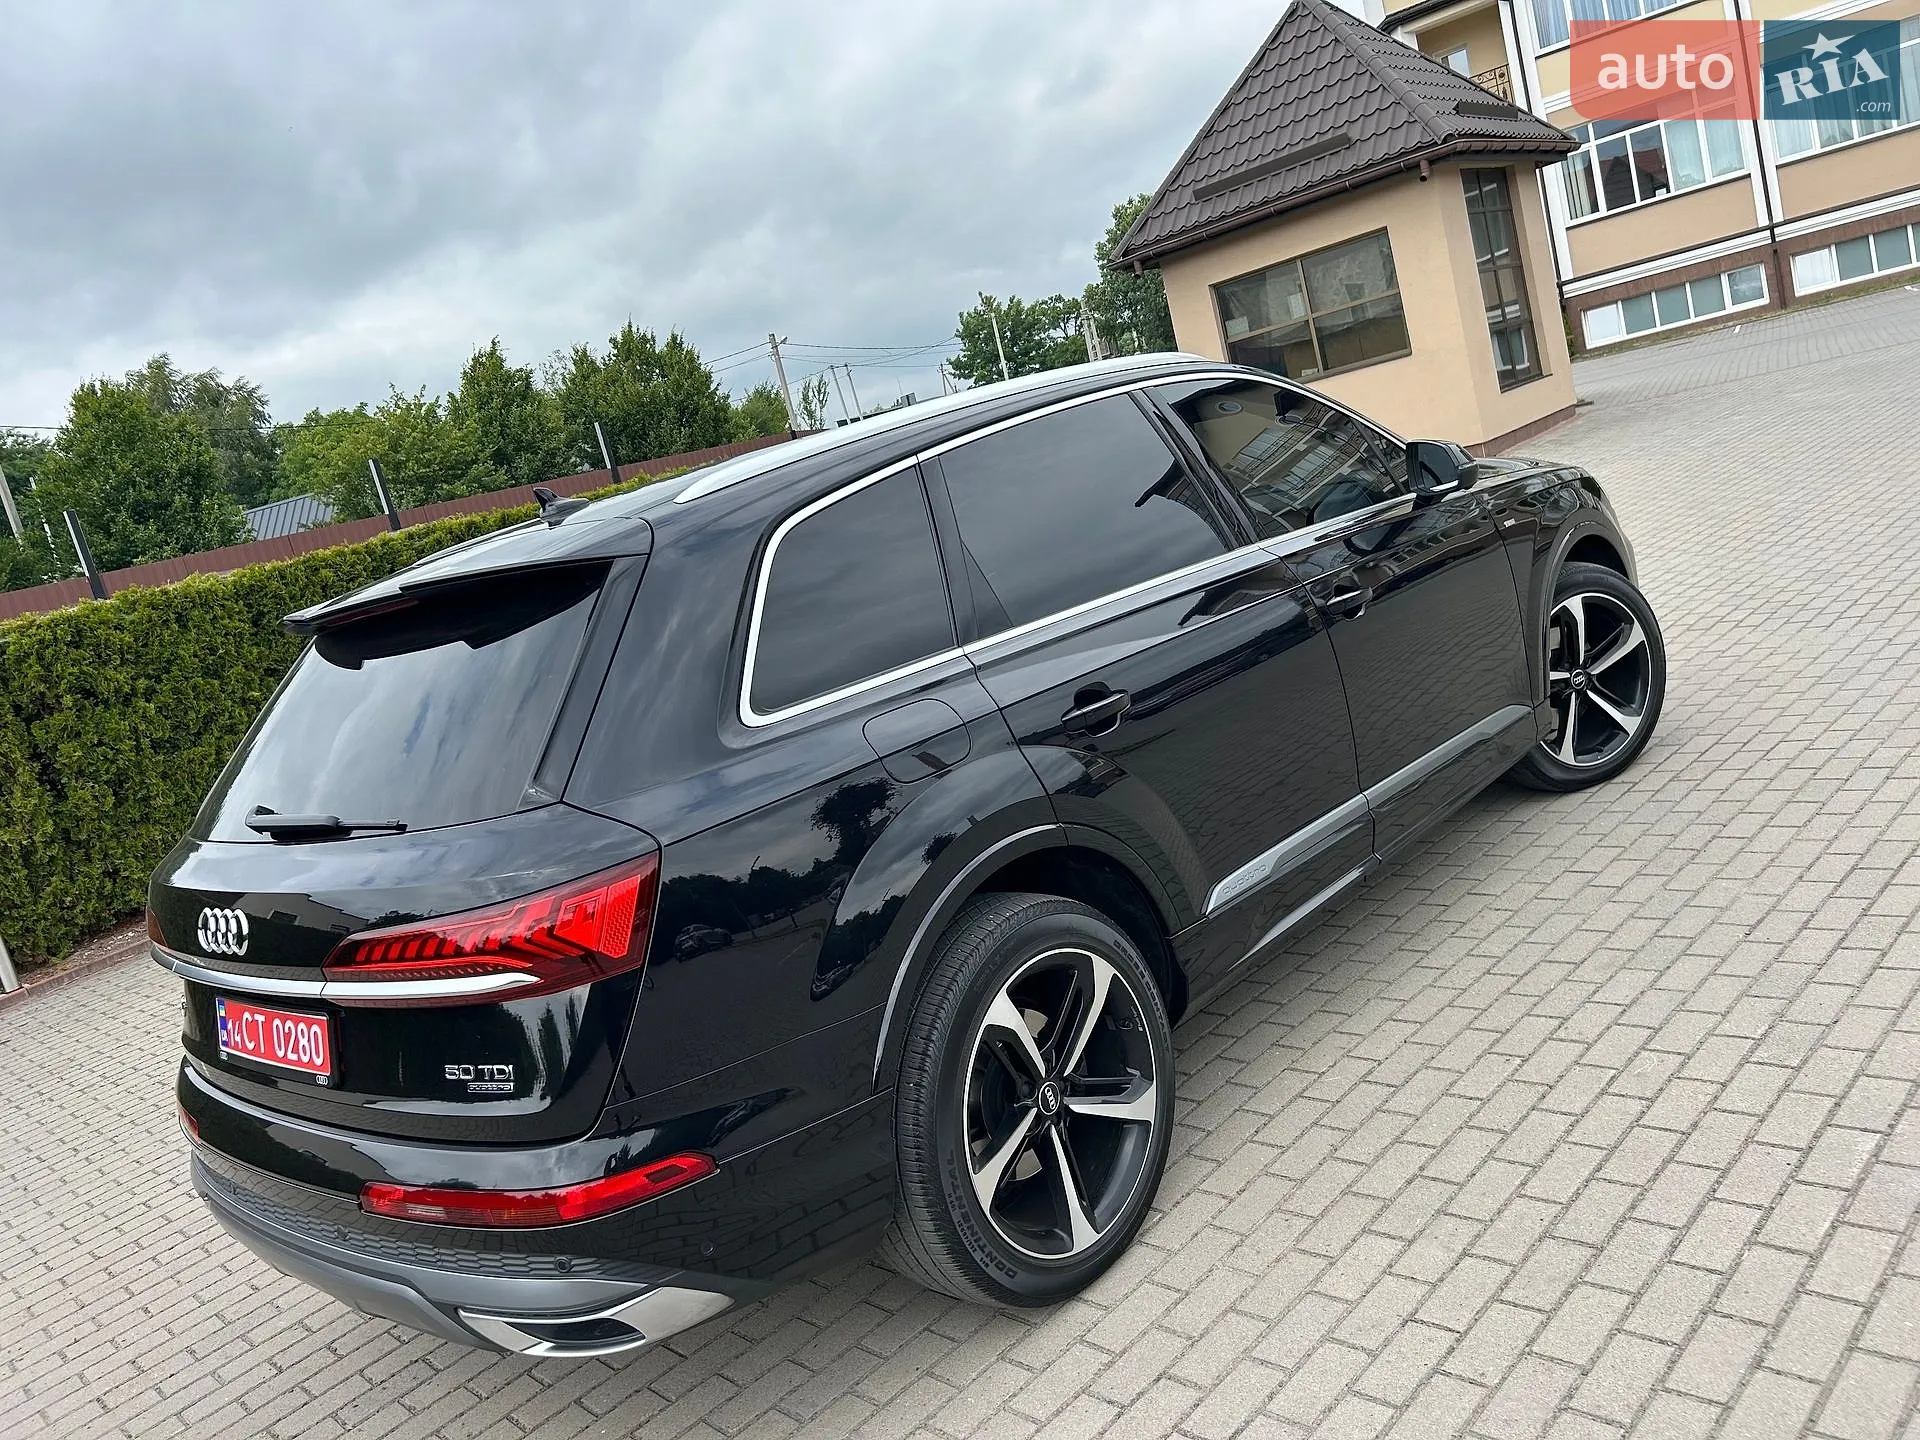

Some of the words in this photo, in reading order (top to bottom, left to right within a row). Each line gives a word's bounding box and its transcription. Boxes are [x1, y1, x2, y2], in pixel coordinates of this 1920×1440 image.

[272, 1017, 324, 1067] 0280
[444, 1064, 475, 1080] 50
[478, 1064, 514, 1080] TDI
